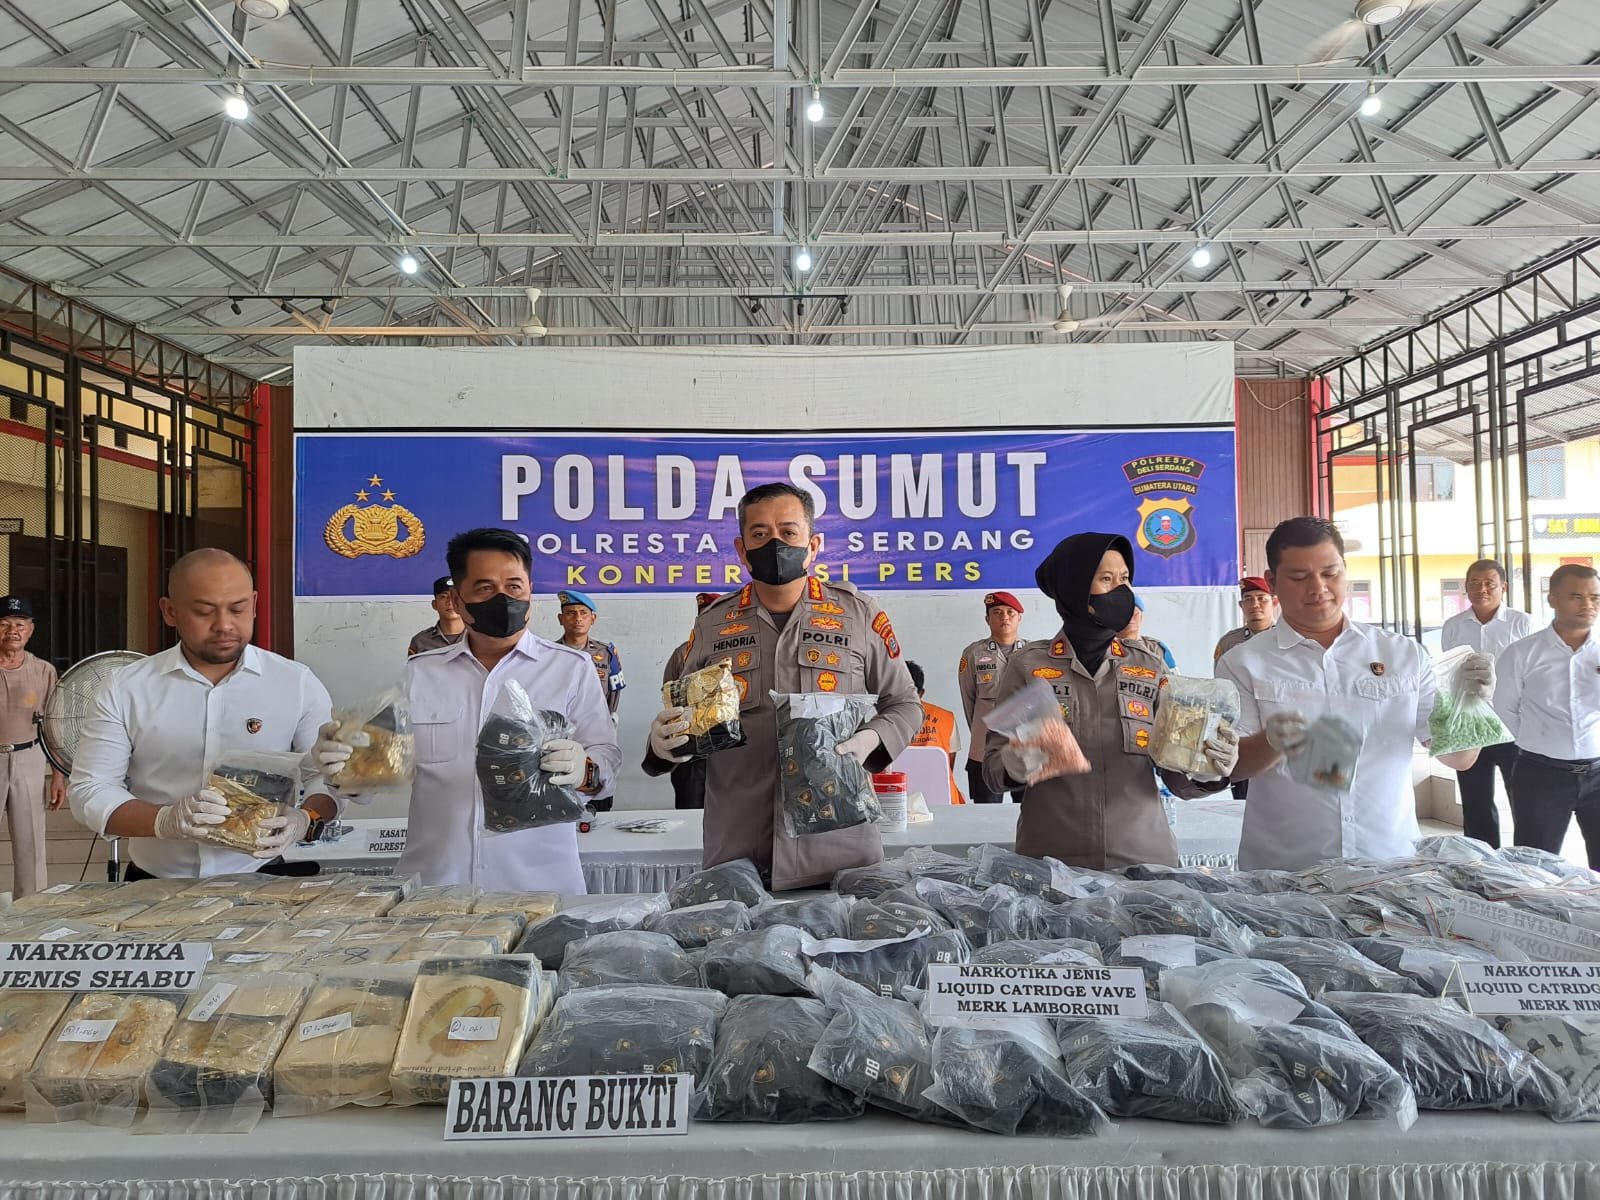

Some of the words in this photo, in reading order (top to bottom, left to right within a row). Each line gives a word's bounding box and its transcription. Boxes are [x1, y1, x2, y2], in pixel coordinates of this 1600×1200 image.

[1131, 457, 1195, 468] POLRESTA
[1137, 466, 1154, 474] DELI
[1155, 464, 1190, 473] SERDANG
[501, 454, 745, 521] POLDA
[789, 452, 1048, 520] SUMUT
[1134, 482, 1171, 494] SUMATERA
[1173, 482, 1195, 493] UTARA
[848, 530, 1035, 552] SERDANG
[567, 563, 849, 585] KONFERSI
[879, 561, 981, 582] PERS
[713, 634, 756, 652] HENDRIA
[802, 631, 849, 647] POLRI
[1119, 681, 1156, 699] POLRI
[369, 842, 406, 851] POLREST
[6, 943, 185, 961] NARKOTIKA
[0, 970, 81, 988] JENIS
[90, 970, 195, 988] SHABU
[959, 966, 1057, 980] NARKOTIKA
[1062, 969, 1112, 981] JENIS
[1484, 965, 1582, 977] NARKOTIKA
[937, 982, 995, 996] LIQUID
[1000, 984, 1087, 997] CATRIDGE
[1094, 986, 1137, 999] VAVE
[1466, 982, 1523, 996] LIQUID
[957, 1000, 1008, 1013] MERK
[1013, 1001, 1120, 1016] LAMBORGINI
[1519, 999, 1570, 1011] MERK
[453, 1078, 577, 1134] BARANG
[585, 1075, 678, 1130] BUKTI
